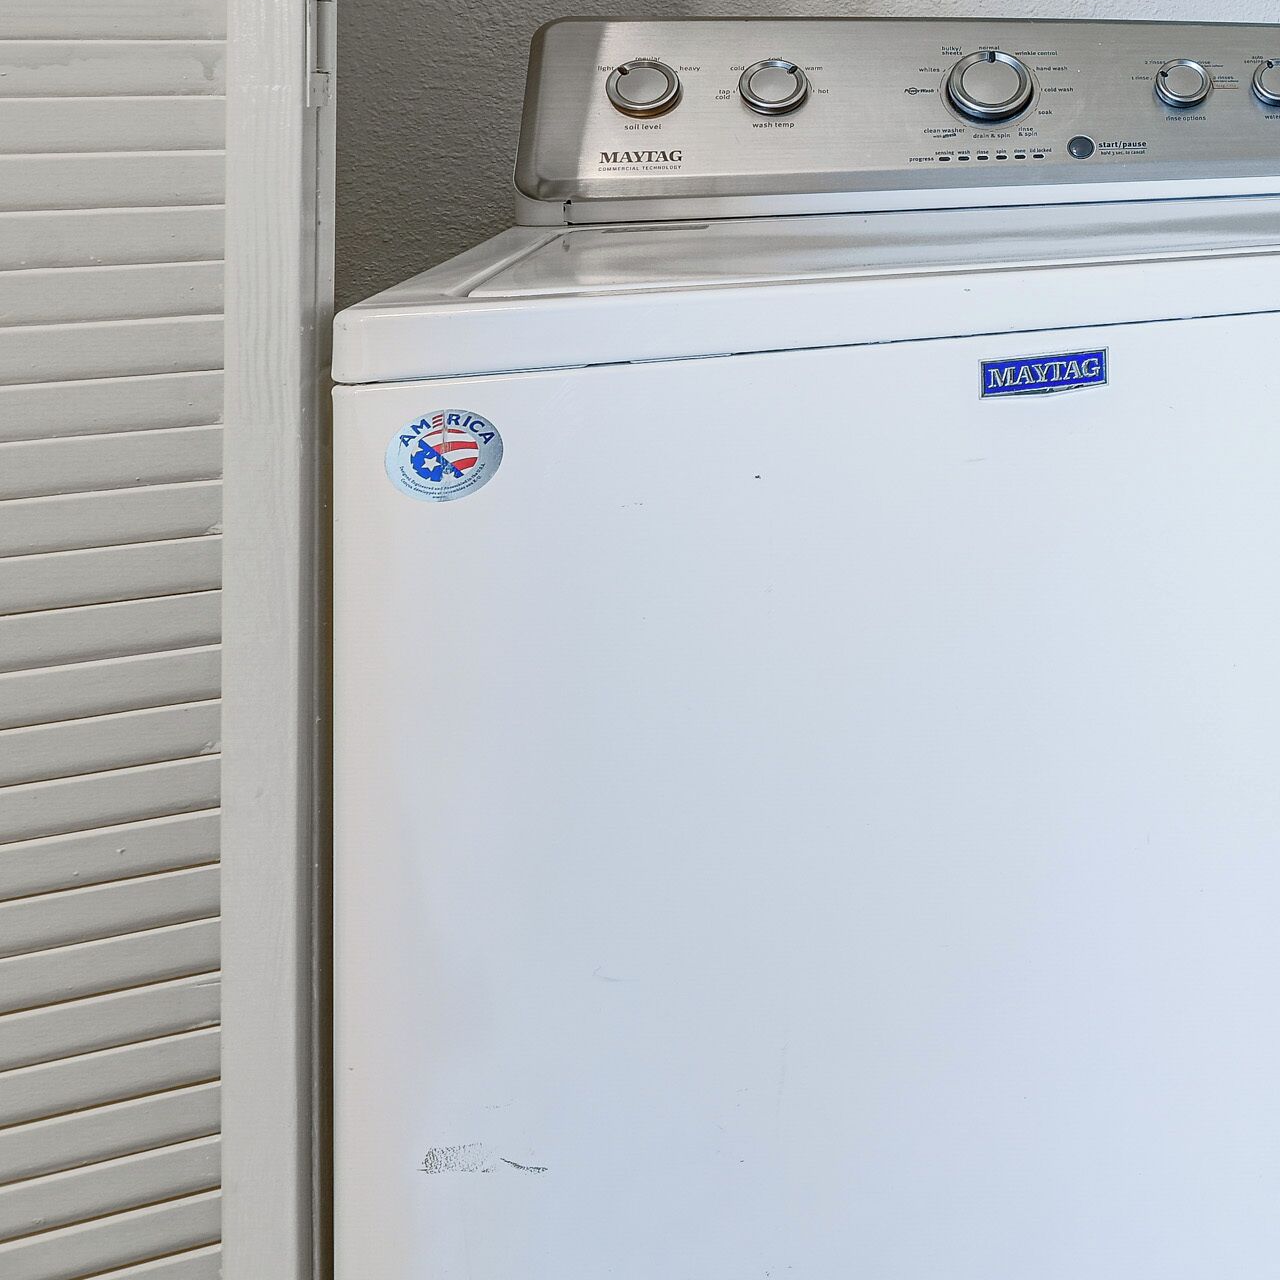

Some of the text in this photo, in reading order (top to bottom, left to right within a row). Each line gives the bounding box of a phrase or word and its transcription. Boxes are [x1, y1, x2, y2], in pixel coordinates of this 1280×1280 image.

[997, 132, 1011, 140] spin
[1098, 140, 1148, 150] start/pause
[599, 150, 683, 164] MAYTAG
[987, 357, 1101, 389] MAYTAG
[399, 413, 495, 447] AMERICA
